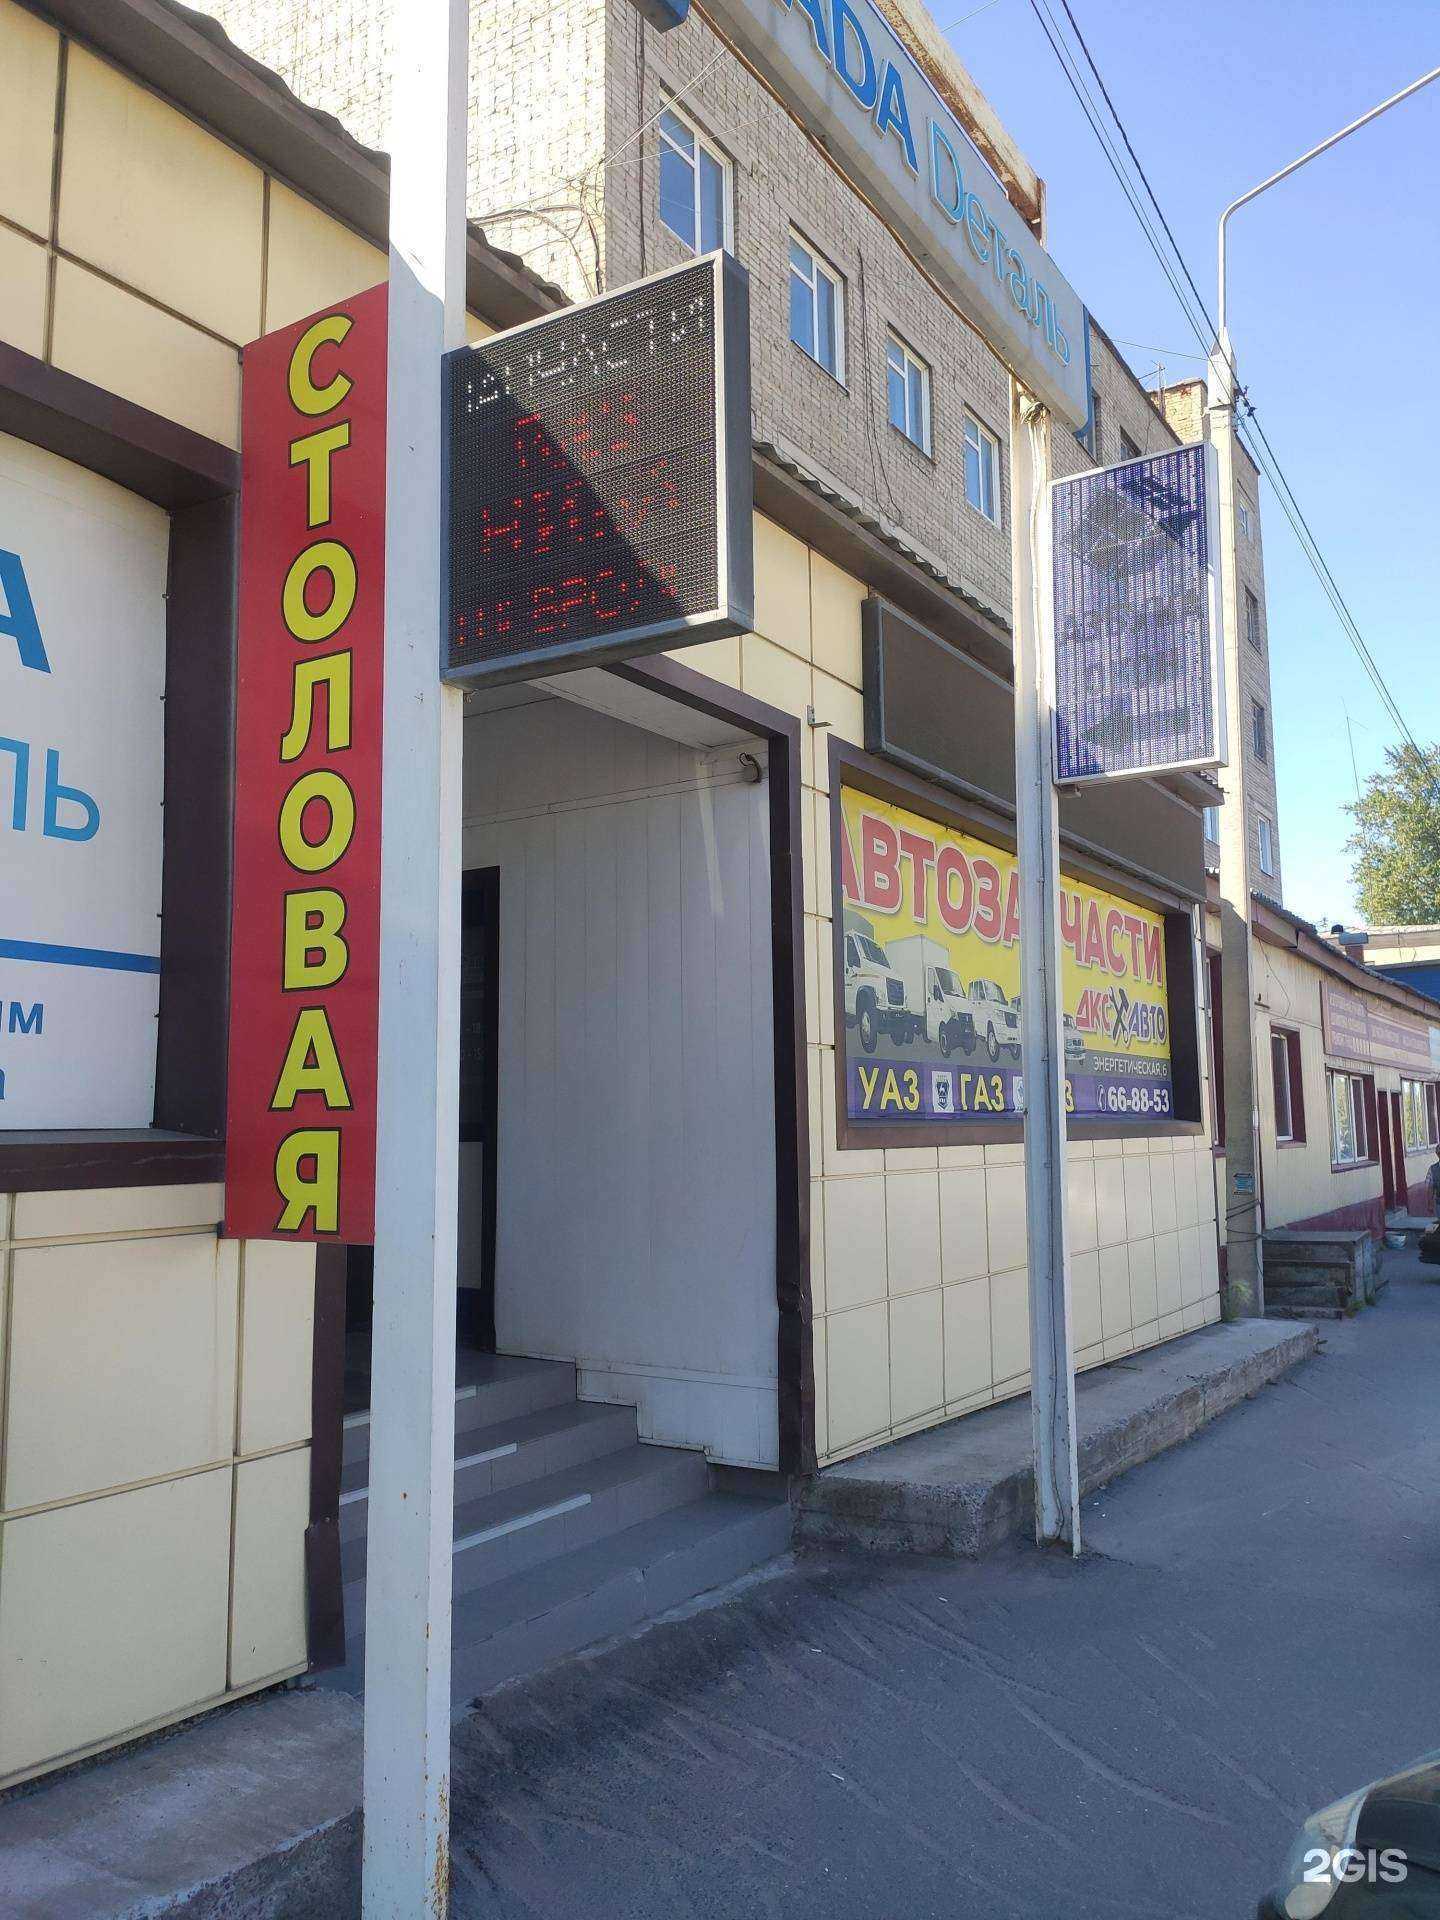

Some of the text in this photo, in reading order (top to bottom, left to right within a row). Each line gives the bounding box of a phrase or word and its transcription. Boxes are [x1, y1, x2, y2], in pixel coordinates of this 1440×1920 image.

[268, 312, 358, 1236] СТОЛОВАЯ
[841, 808, 1163, 988] ВТОЗАЧАСТИ
[858, 1066, 1005, 1112] УАЗ ГАЗ
[1107, 1086, 1170, 1113] 66-88-53
